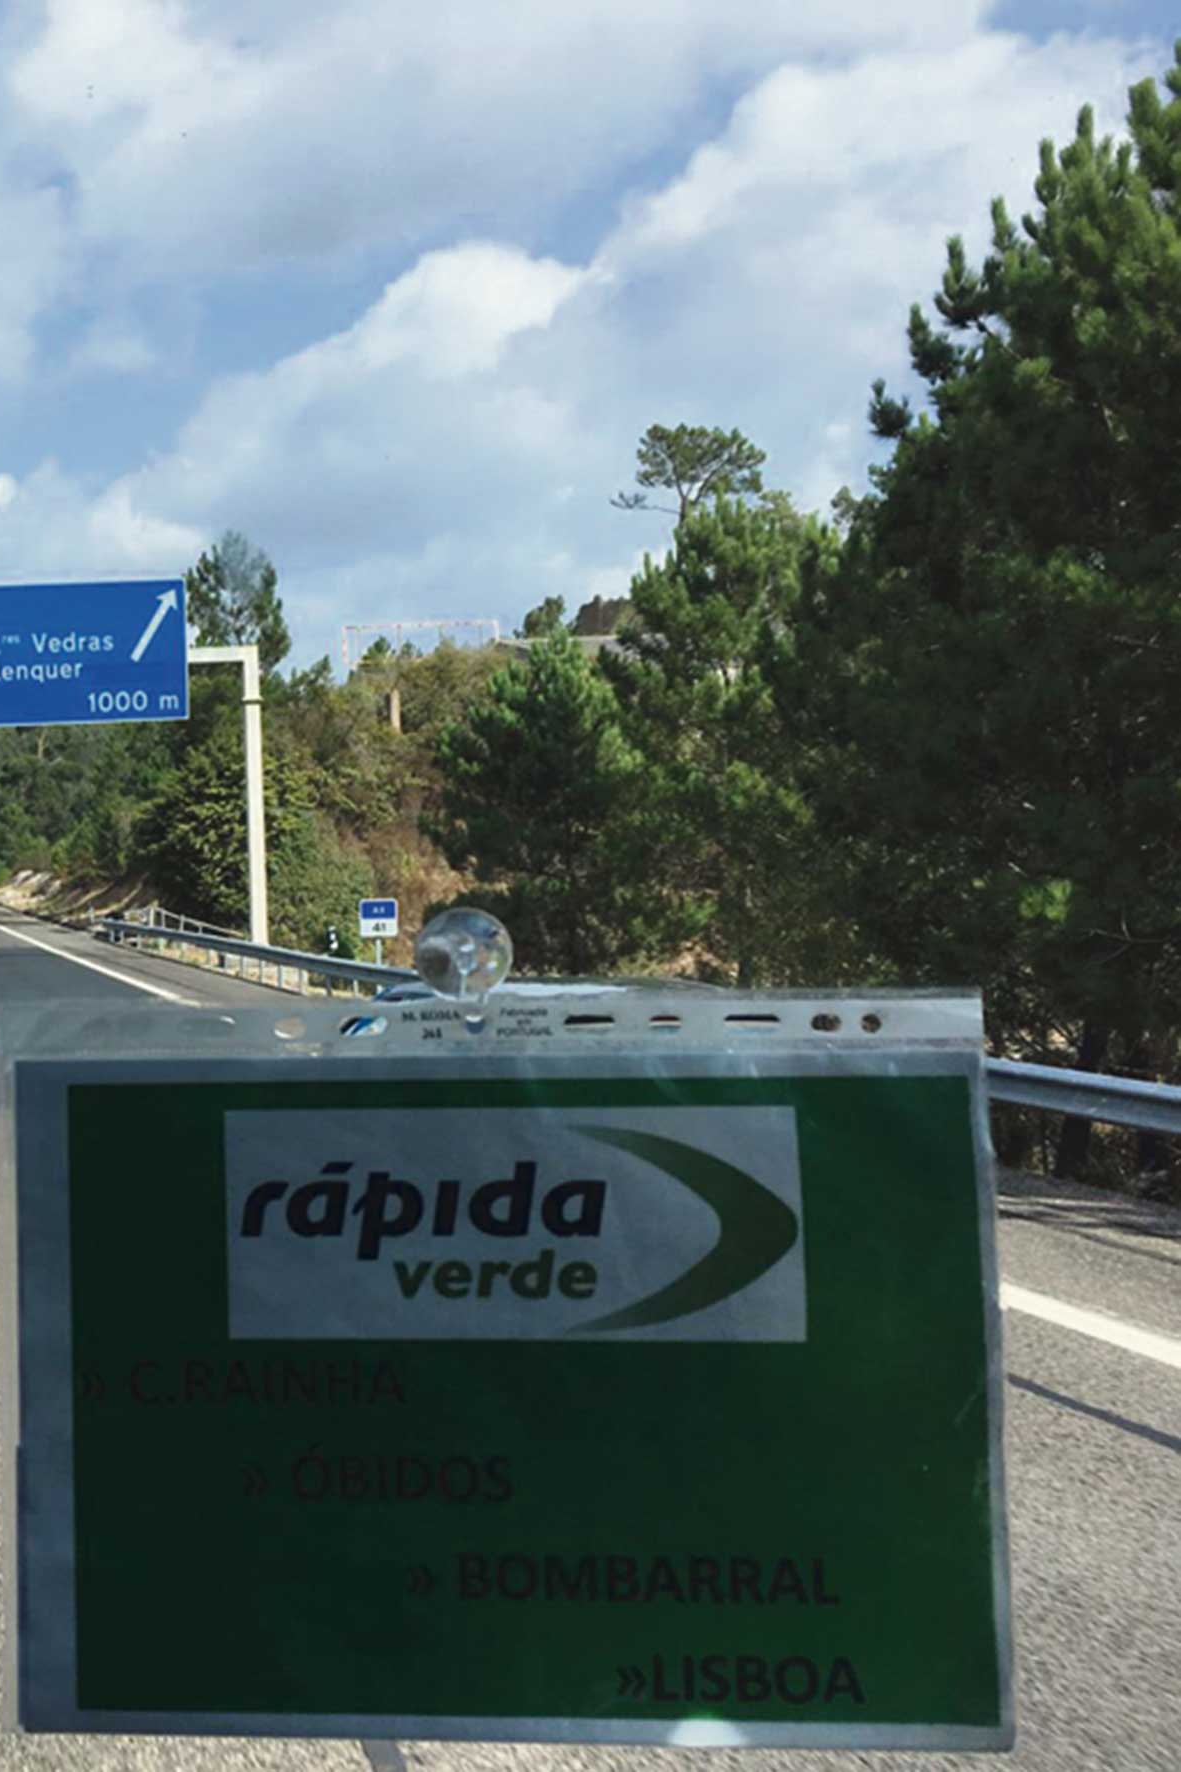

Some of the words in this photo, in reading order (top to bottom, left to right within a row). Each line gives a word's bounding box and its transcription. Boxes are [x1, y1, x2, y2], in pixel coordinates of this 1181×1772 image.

[31, 632, 114, 653] Vedras
[87, 690, 148, 713] 1000
[159, 694, 180, 711] m
[240, 1161, 607, 1261] rápida
[393, 1249, 598, 1299] verde
[290, 1441, 514, 1504] ÓBIDOS
[455, 1551, 841, 1606] BOMBARRAL
